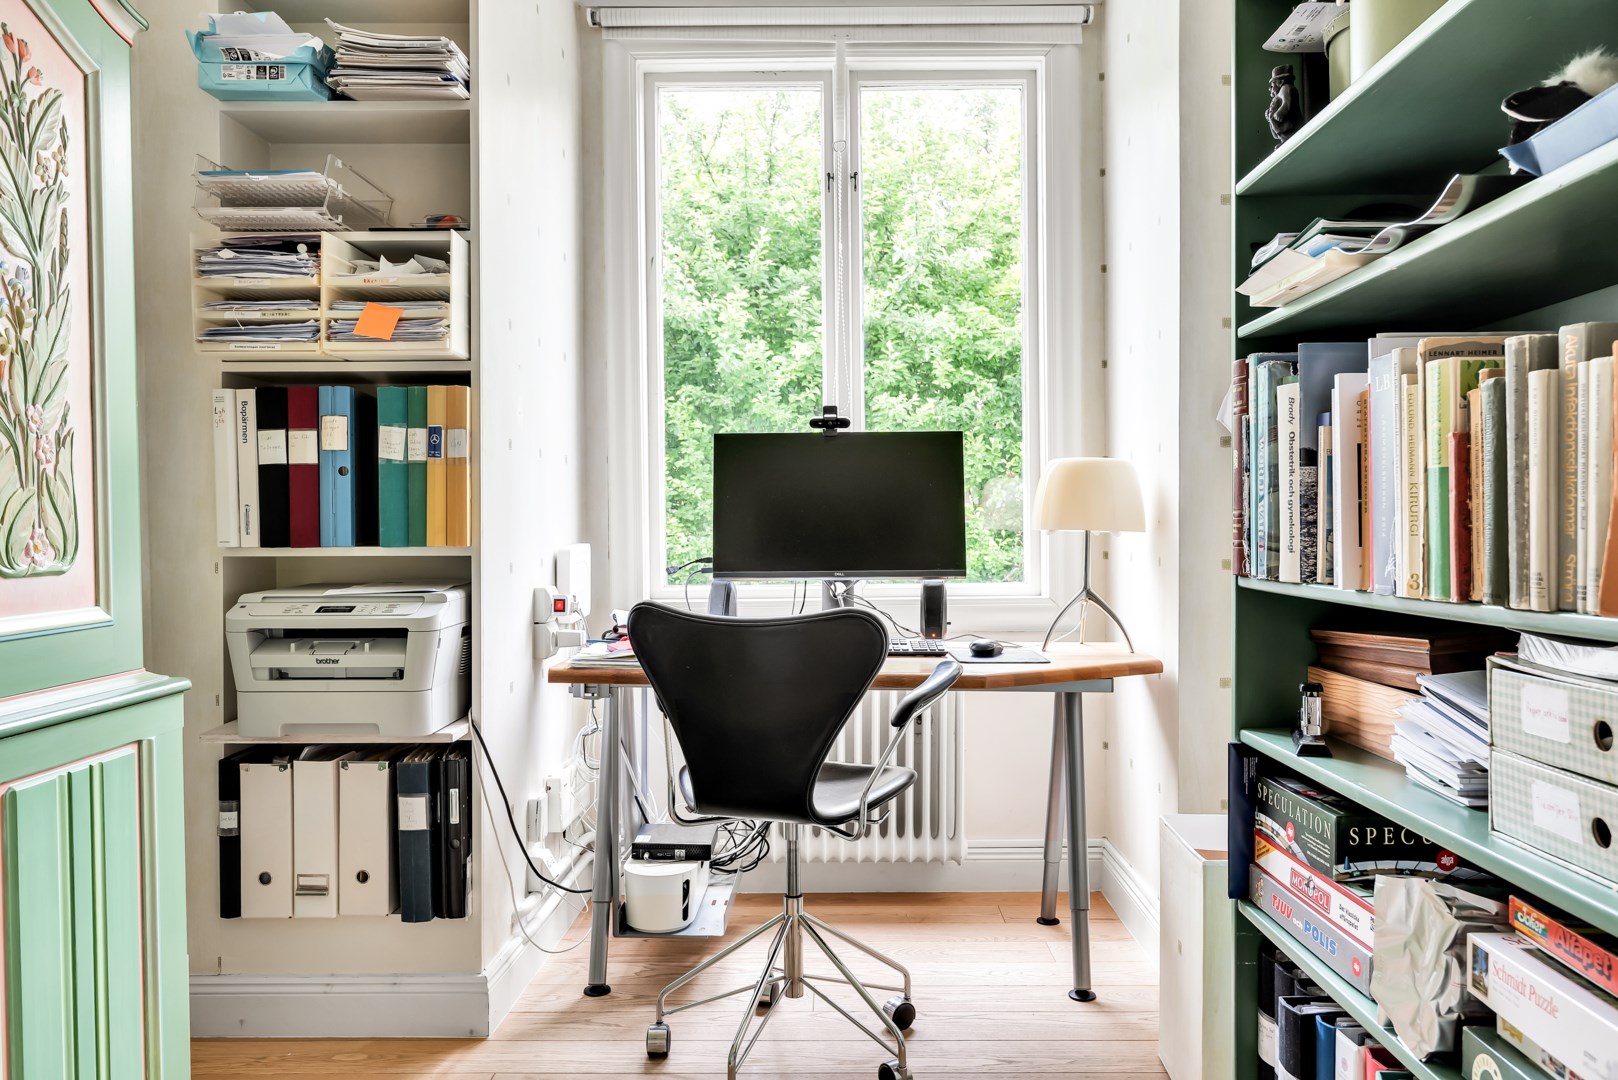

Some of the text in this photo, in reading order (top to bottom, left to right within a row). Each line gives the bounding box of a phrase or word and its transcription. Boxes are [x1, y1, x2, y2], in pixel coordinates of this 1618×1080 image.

[1564, 335, 1579, 379] Akuta
[1375, 374, 1390, 393] LB
[240, 400, 248, 444] Bopärmen
[1257, 437, 1265, 496] WORLD
[1287, 397, 1296, 554] Brody Obstetrik och gynekologi
[1407, 393, 1419, 537] EDLUND, HEIMANN KIRURGI
[1564, 382, 1578, 539] Infektionssjukdomar
[1257, 500, 1265, 538] WAR
[1410, 573, 1420, 591] 3
[315, 657, 340, 665] brother
[1257, 782, 1331, 840] SPECULATION
[1440, 855, 1455, 866] alga
[1291, 873, 1329, 909] MONOPOL
[1271, 893, 1293, 920] TJUV
[1292, 917, 1303, 931] och
[1303, 917, 1338, 957] POLIS
[1554, 926, 1613, 981] Alfapet
[1492, 959, 1527, 998] Schmidt
[1528, 983, 1560, 1019] Puzzle
